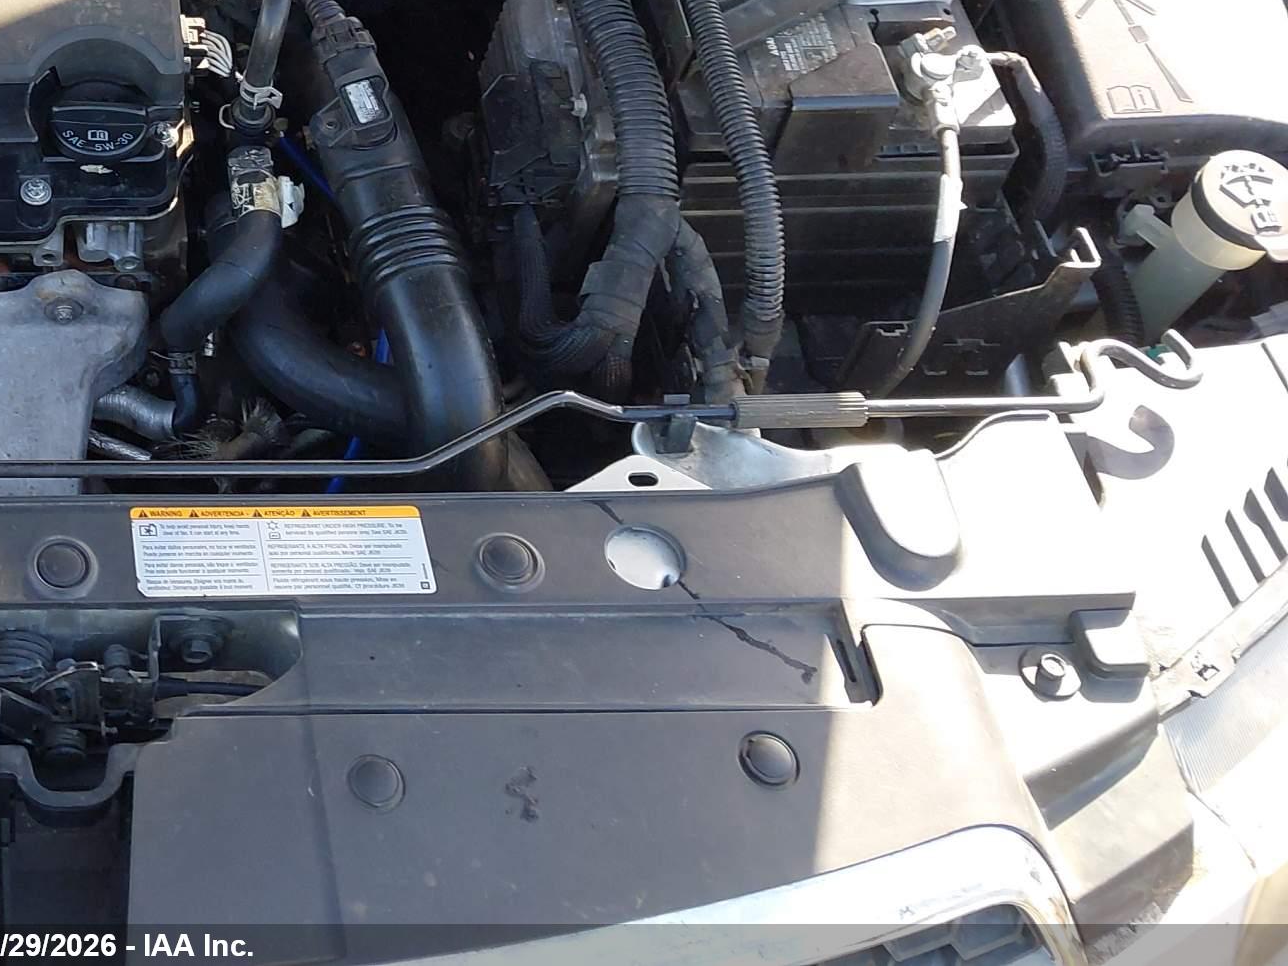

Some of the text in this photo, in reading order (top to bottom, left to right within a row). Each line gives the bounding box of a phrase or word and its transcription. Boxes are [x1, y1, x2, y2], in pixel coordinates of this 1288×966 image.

[62, 130, 134, 151] SAE 5W-30
[264, 509, 295, 517] ATENÇÃO
